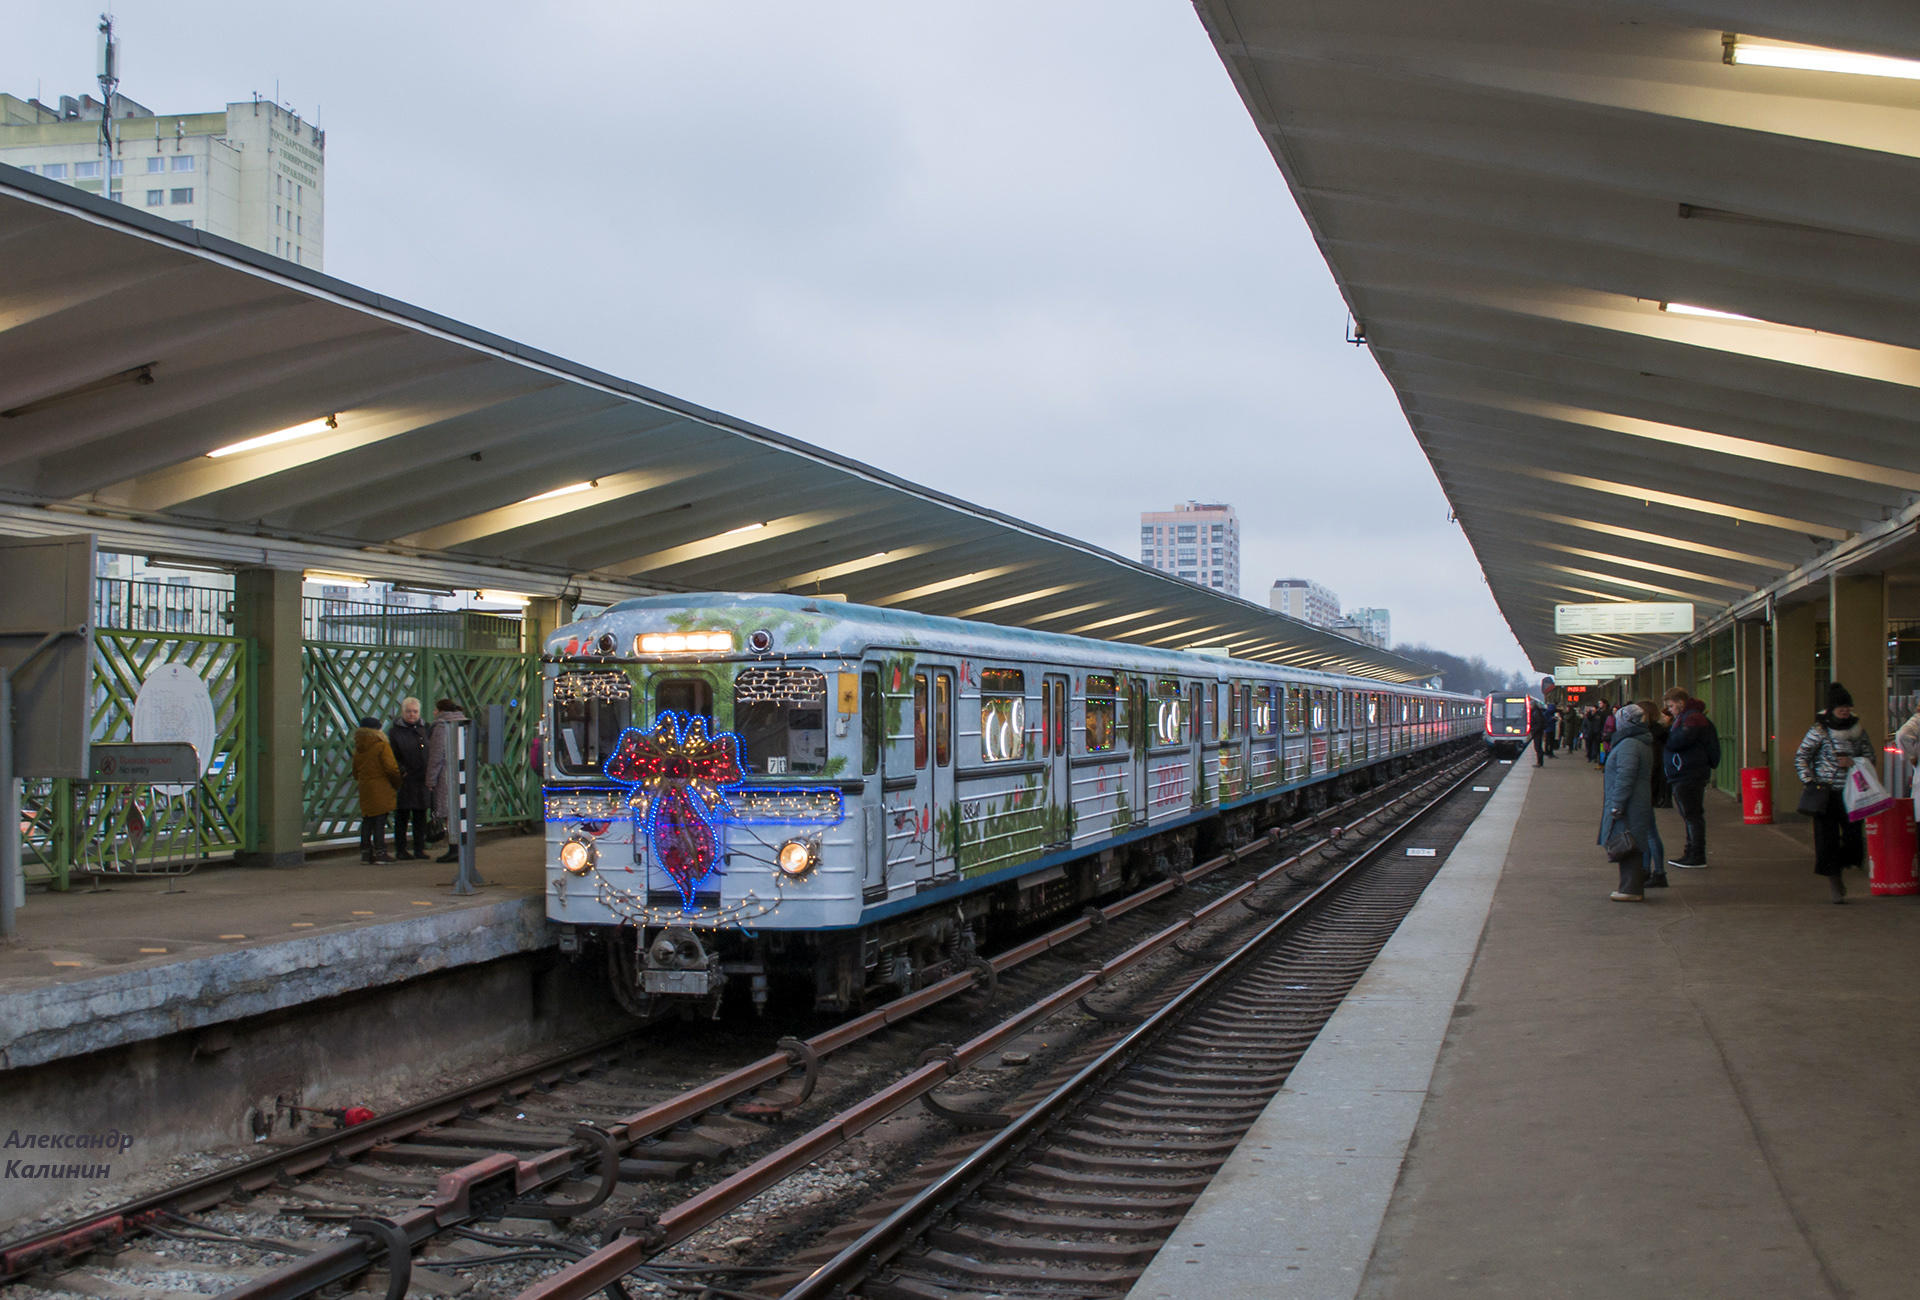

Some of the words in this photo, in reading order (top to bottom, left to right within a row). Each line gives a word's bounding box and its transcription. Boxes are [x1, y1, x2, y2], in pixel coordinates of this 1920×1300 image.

[279, 148, 317, 175] УНИВЕРСИТЕТ
[278, 162, 316, 189] УПРАВЛЕНИЯ
[120, 766, 130, 774] No
[131, 766, 150, 775] entry
[1157, 762, 1184, 807] 2020
